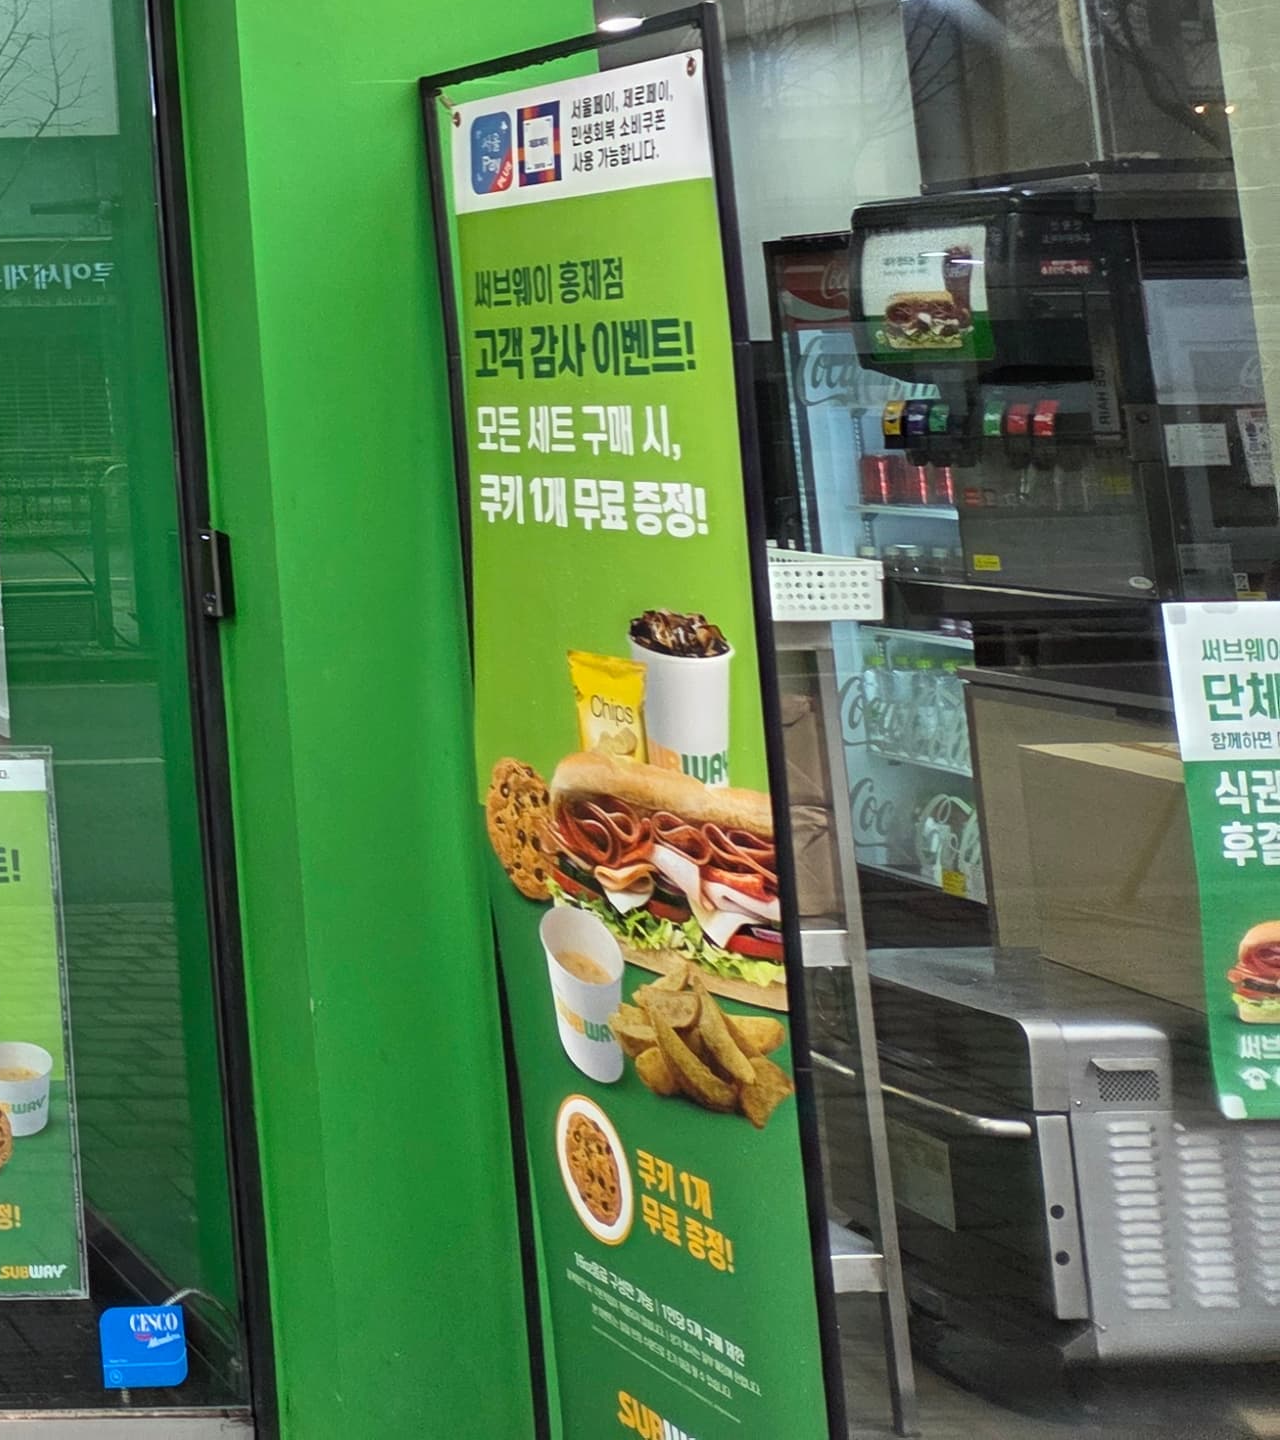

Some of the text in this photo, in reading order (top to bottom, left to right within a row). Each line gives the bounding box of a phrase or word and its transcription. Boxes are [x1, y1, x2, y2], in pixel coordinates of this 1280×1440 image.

[571, 109, 666, 147] 민생회복 소비쿠폰
[572, 139, 660, 172] 사용 가능합니다.
[474, 256, 624, 309] 써브웨이 홍제점
[474, 318, 696, 380] 고객 감사 이벤트!
[477, 405, 682, 461] 모든 세트 구매 시,
[480, 474, 709, 538] 쿠키 1개 무료 증정!
[590, 694, 634, 727] Chips
[1210, 731, 1272, 751] 함께하면
[636, 1148, 713, 1220] 쿠키 1개
[641, 1193, 735, 1274] 무료 증정!
